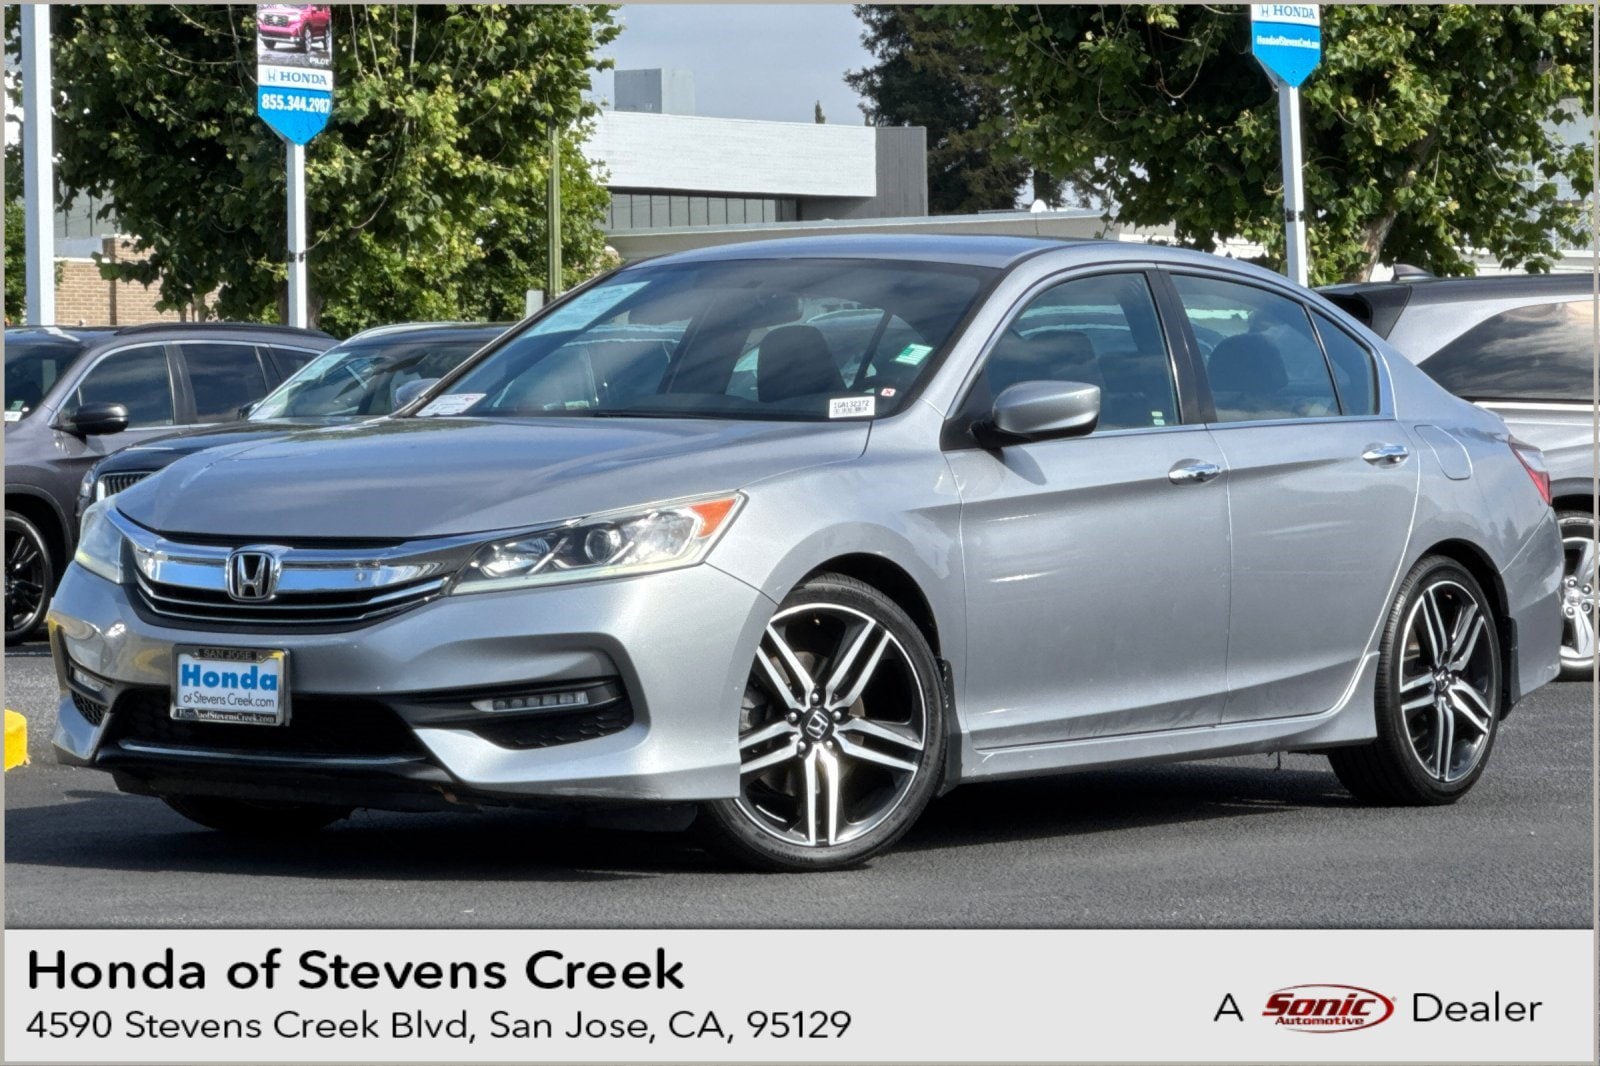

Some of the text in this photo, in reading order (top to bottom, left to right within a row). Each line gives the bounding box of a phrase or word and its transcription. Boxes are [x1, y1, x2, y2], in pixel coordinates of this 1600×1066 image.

[1273, 5, 1316, 19] HONDA
[309, 57, 330, 66] PILOT
[280, 71, 328, 85] HONDA
[261, 93, 330, 114] 855.344.2987
[203, 648, 252, 660] SAN JOSE
[181, 663, 278, 691] Honda
[183, 690, 275, 708] of Stevens Creek.com
